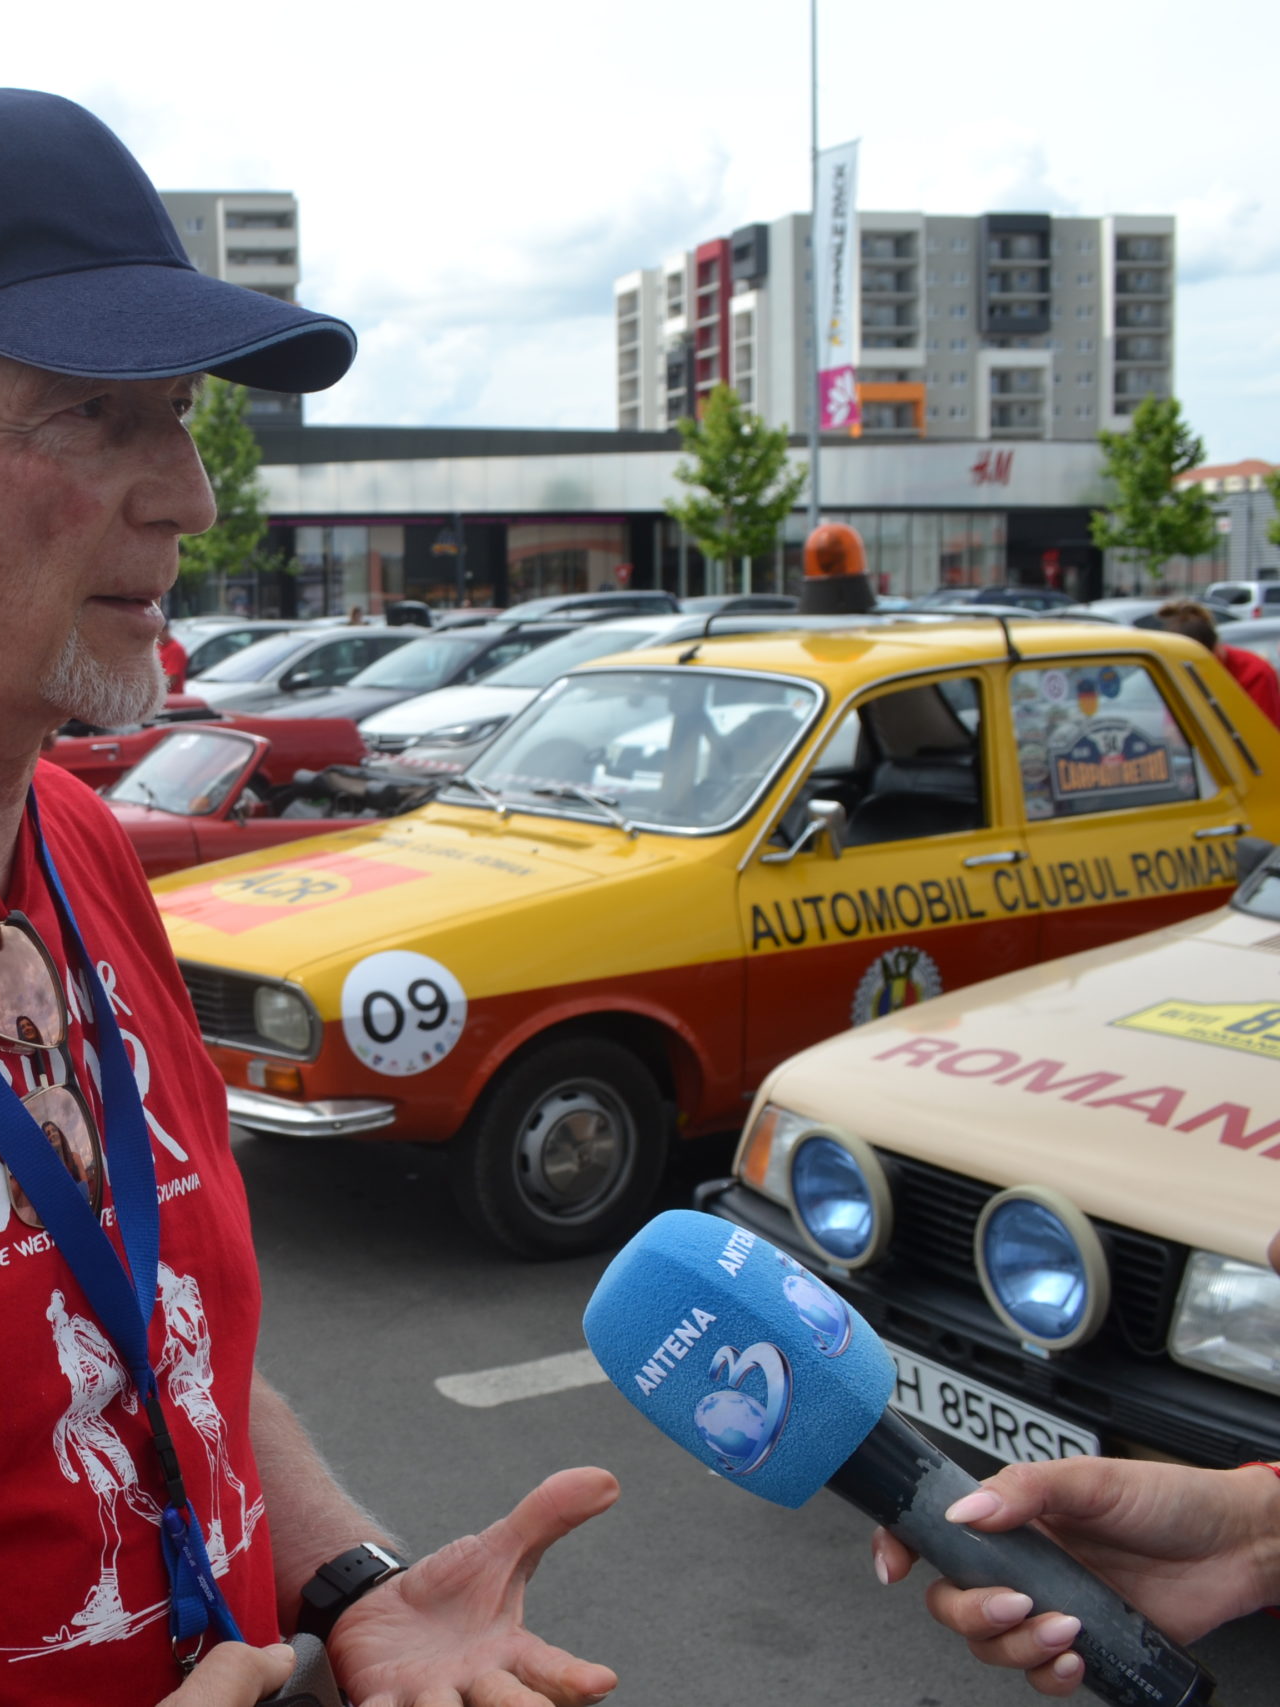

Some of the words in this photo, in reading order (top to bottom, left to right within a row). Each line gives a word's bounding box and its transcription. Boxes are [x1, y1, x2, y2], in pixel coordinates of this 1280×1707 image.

[752, 876, 987, 951] AUTOMOBIL
[993, 856, 1129, 912] CLUBUL
[363, 979, 449, 1044] 09
[872, 1037, 1280, 1161] ROMAN
[13, 1231, 56, 1257] WES
[156, 1172, 201, 1205] SYLVANIA
[716, 1226, 758, 1278] ANTEN
[634, 1307, 717, 1397] ANTENA
[894, 1358, 923, 1412] H
